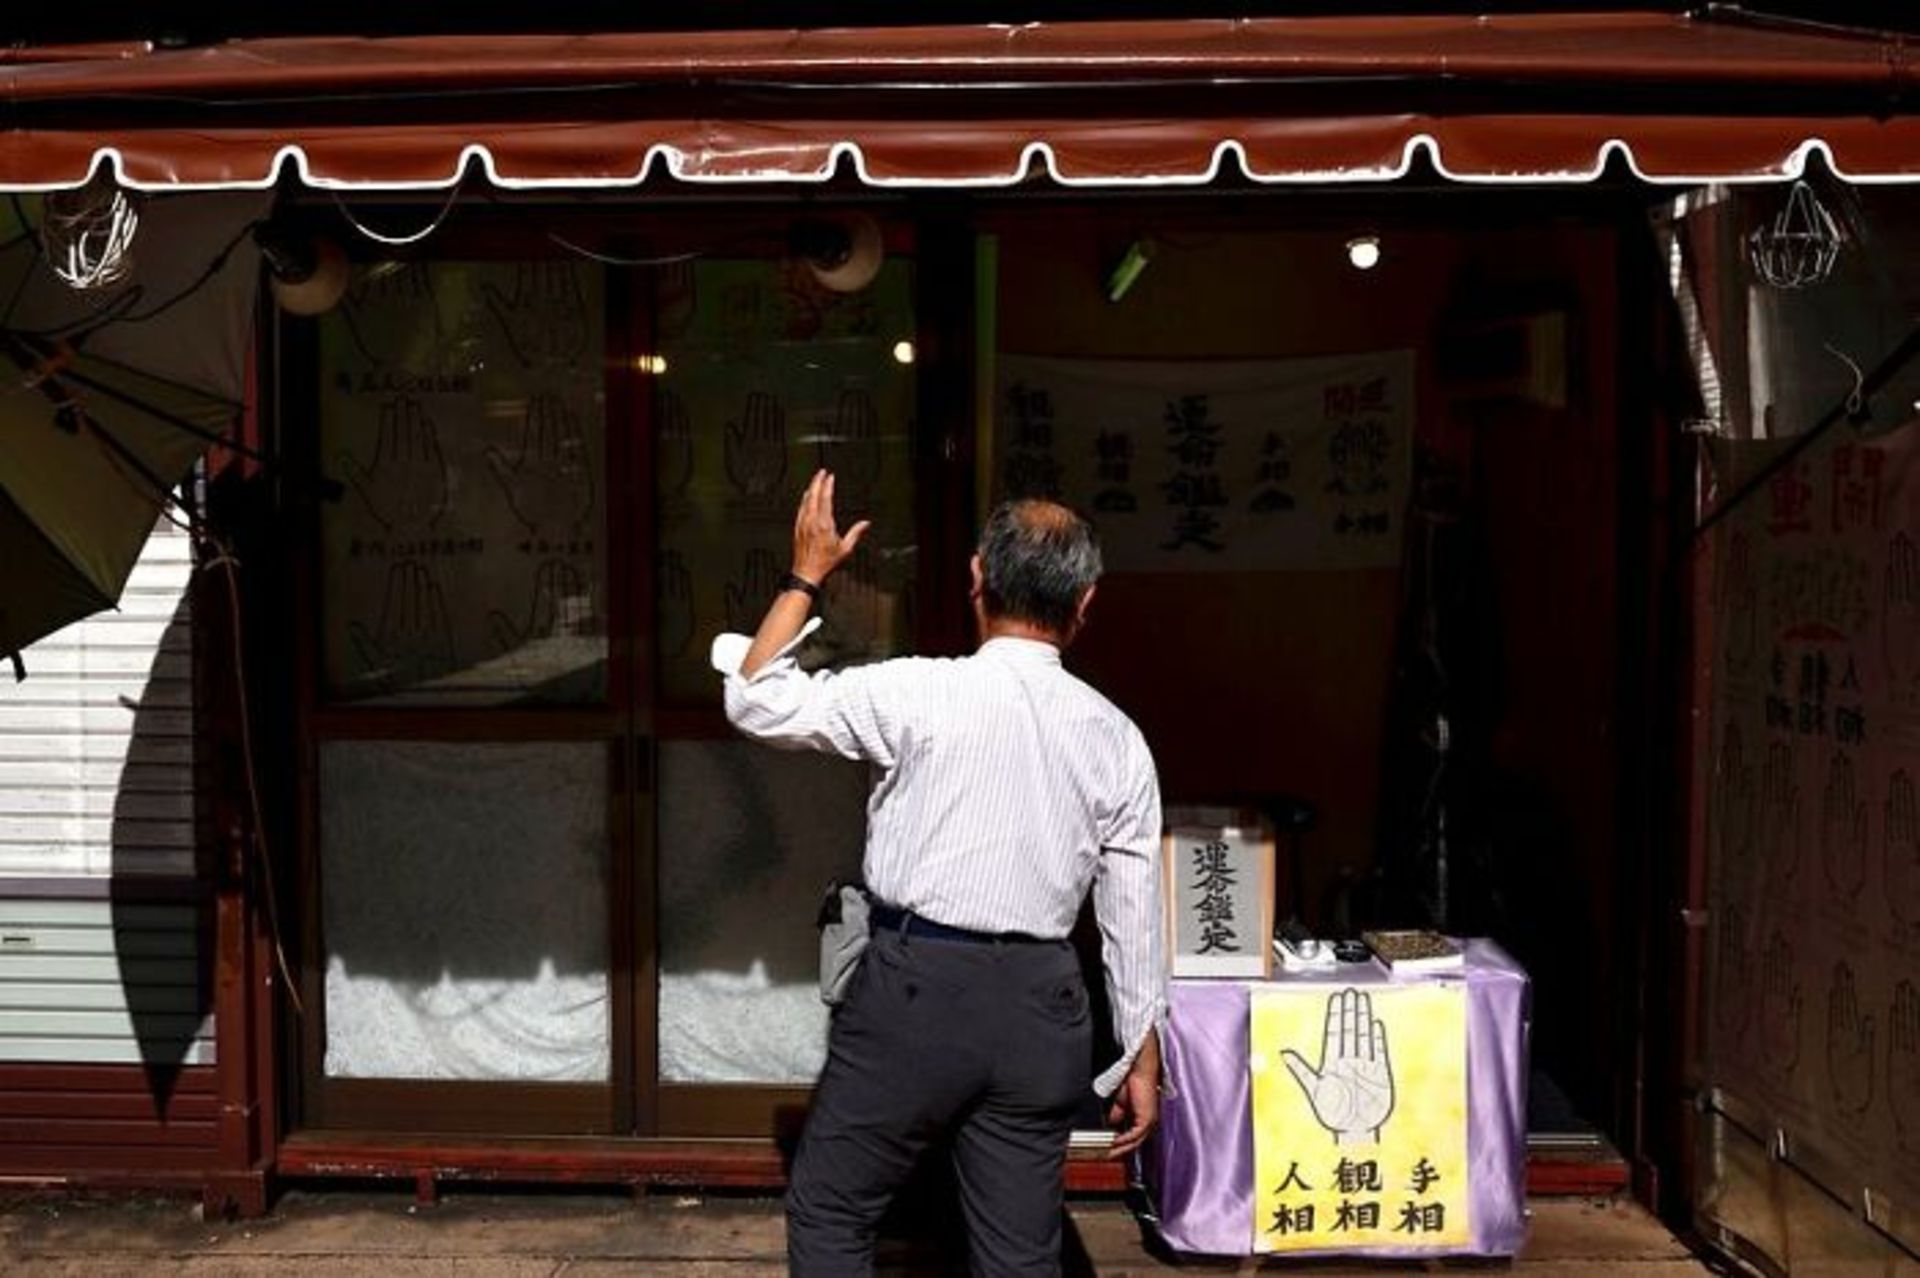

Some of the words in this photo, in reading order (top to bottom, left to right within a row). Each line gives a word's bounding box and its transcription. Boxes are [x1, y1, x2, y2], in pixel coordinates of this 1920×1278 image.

[1191, 843, 1241, 955] 運命鑑定
[1268, 1161, 1314, 1234] 人相
[1330, 1157, 1383, 1232] 観相
[1393, 1158, 1444, 1234] 手相
